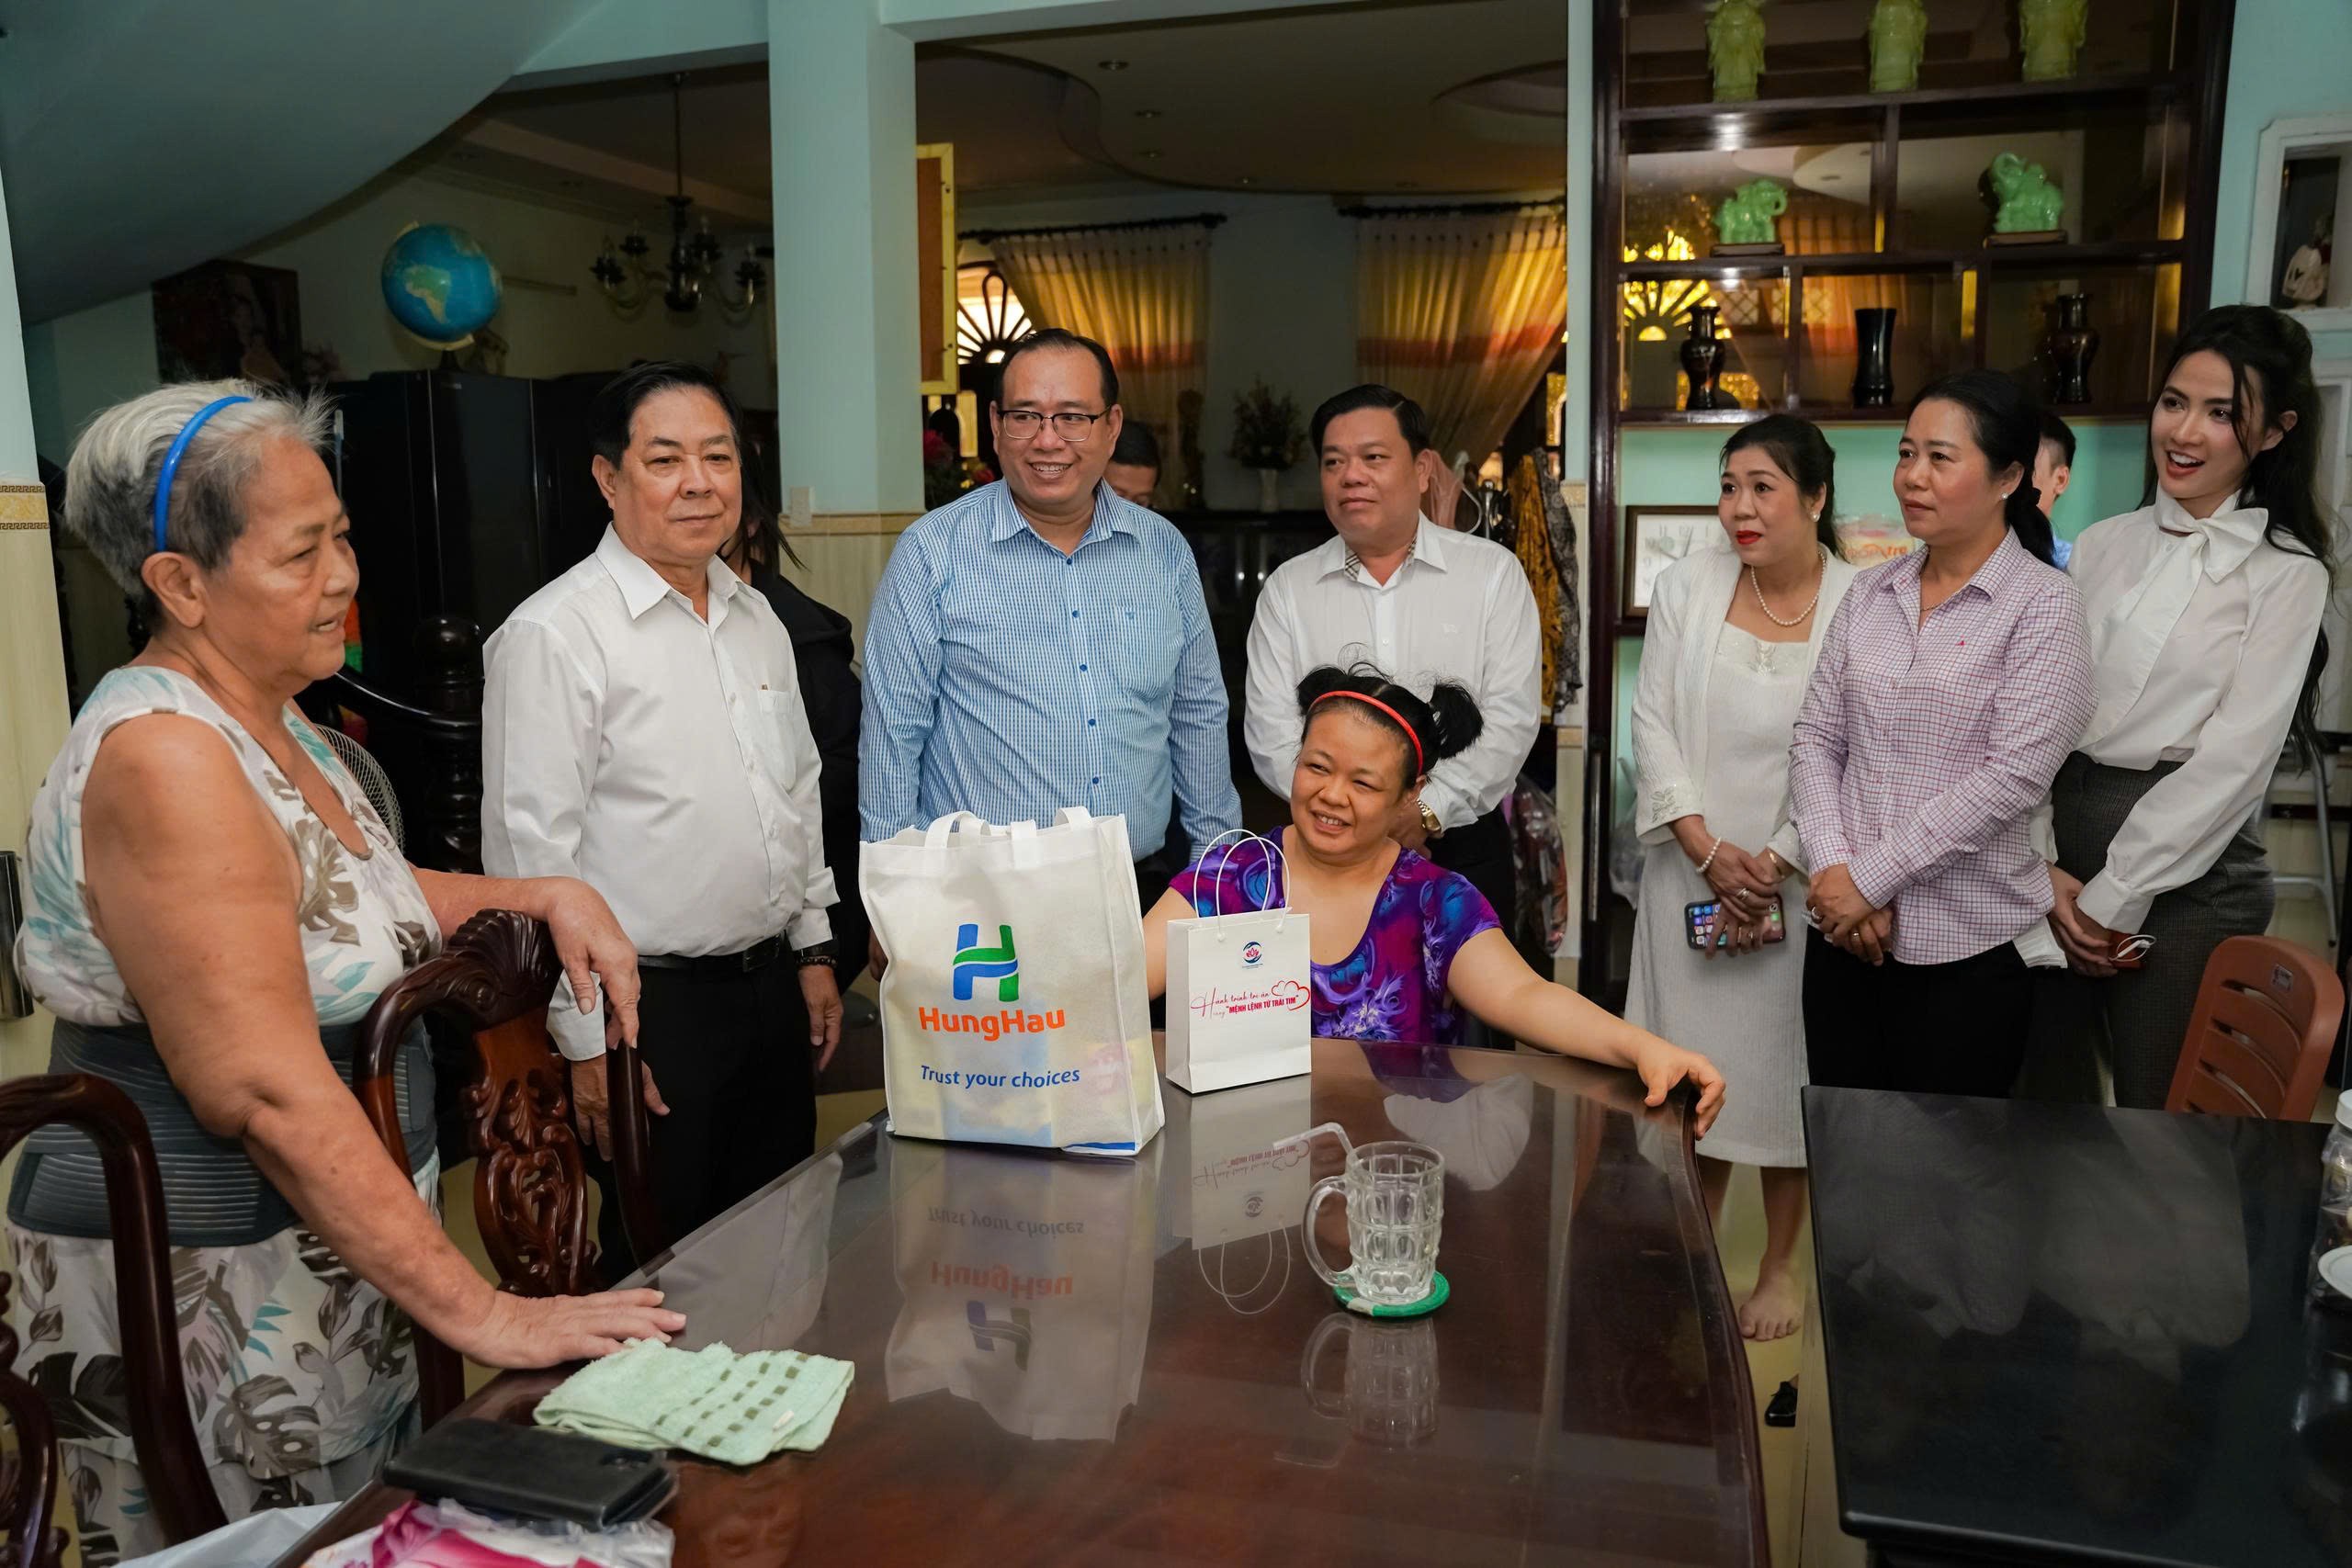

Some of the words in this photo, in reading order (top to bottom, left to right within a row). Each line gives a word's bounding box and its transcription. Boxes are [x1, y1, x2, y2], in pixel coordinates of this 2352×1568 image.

[918, 1007, 1066, 1042] HungHau
[921, 1065, 960, 1085] Trust
[966, 1073, 1007, 1089] your
[1012, 1069, 1080, 1089] choices
